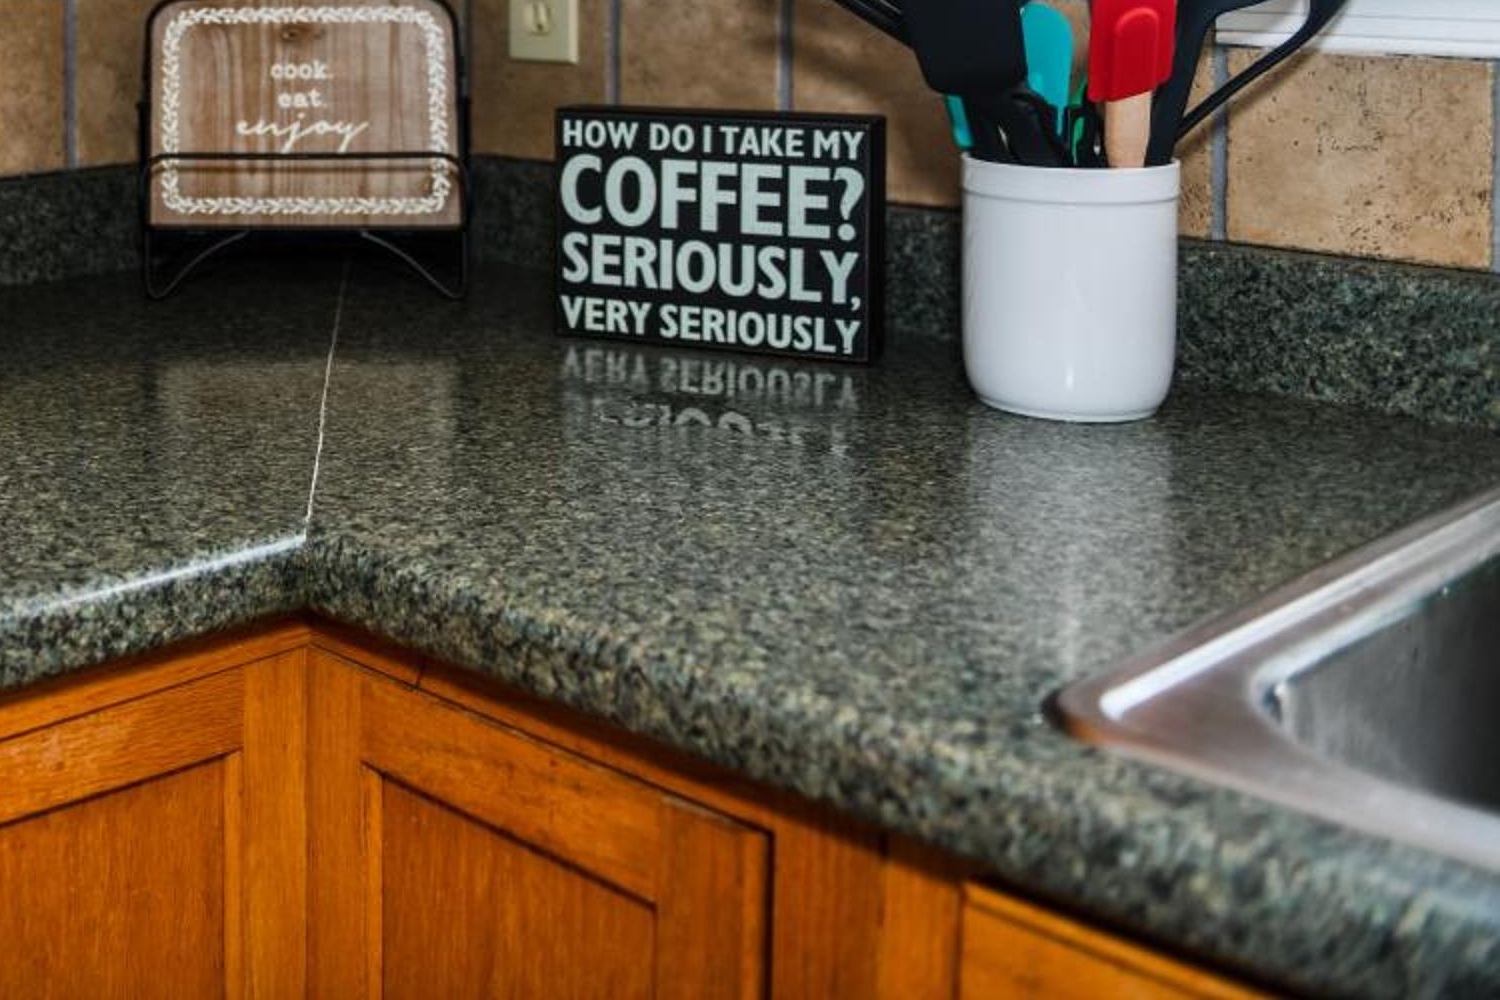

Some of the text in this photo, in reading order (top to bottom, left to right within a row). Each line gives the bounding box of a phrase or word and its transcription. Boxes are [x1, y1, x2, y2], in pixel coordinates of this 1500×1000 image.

[236, 111, 369, 154] enjoy
[562, 119, 864, 160] HOW DO I TAKE MY
[560, 153, 865, 241] COFFEE?
[561, 231, 861, 311] SERIOUSLY,
[560, 295, 861, 355] VERY SERIOUSLY
